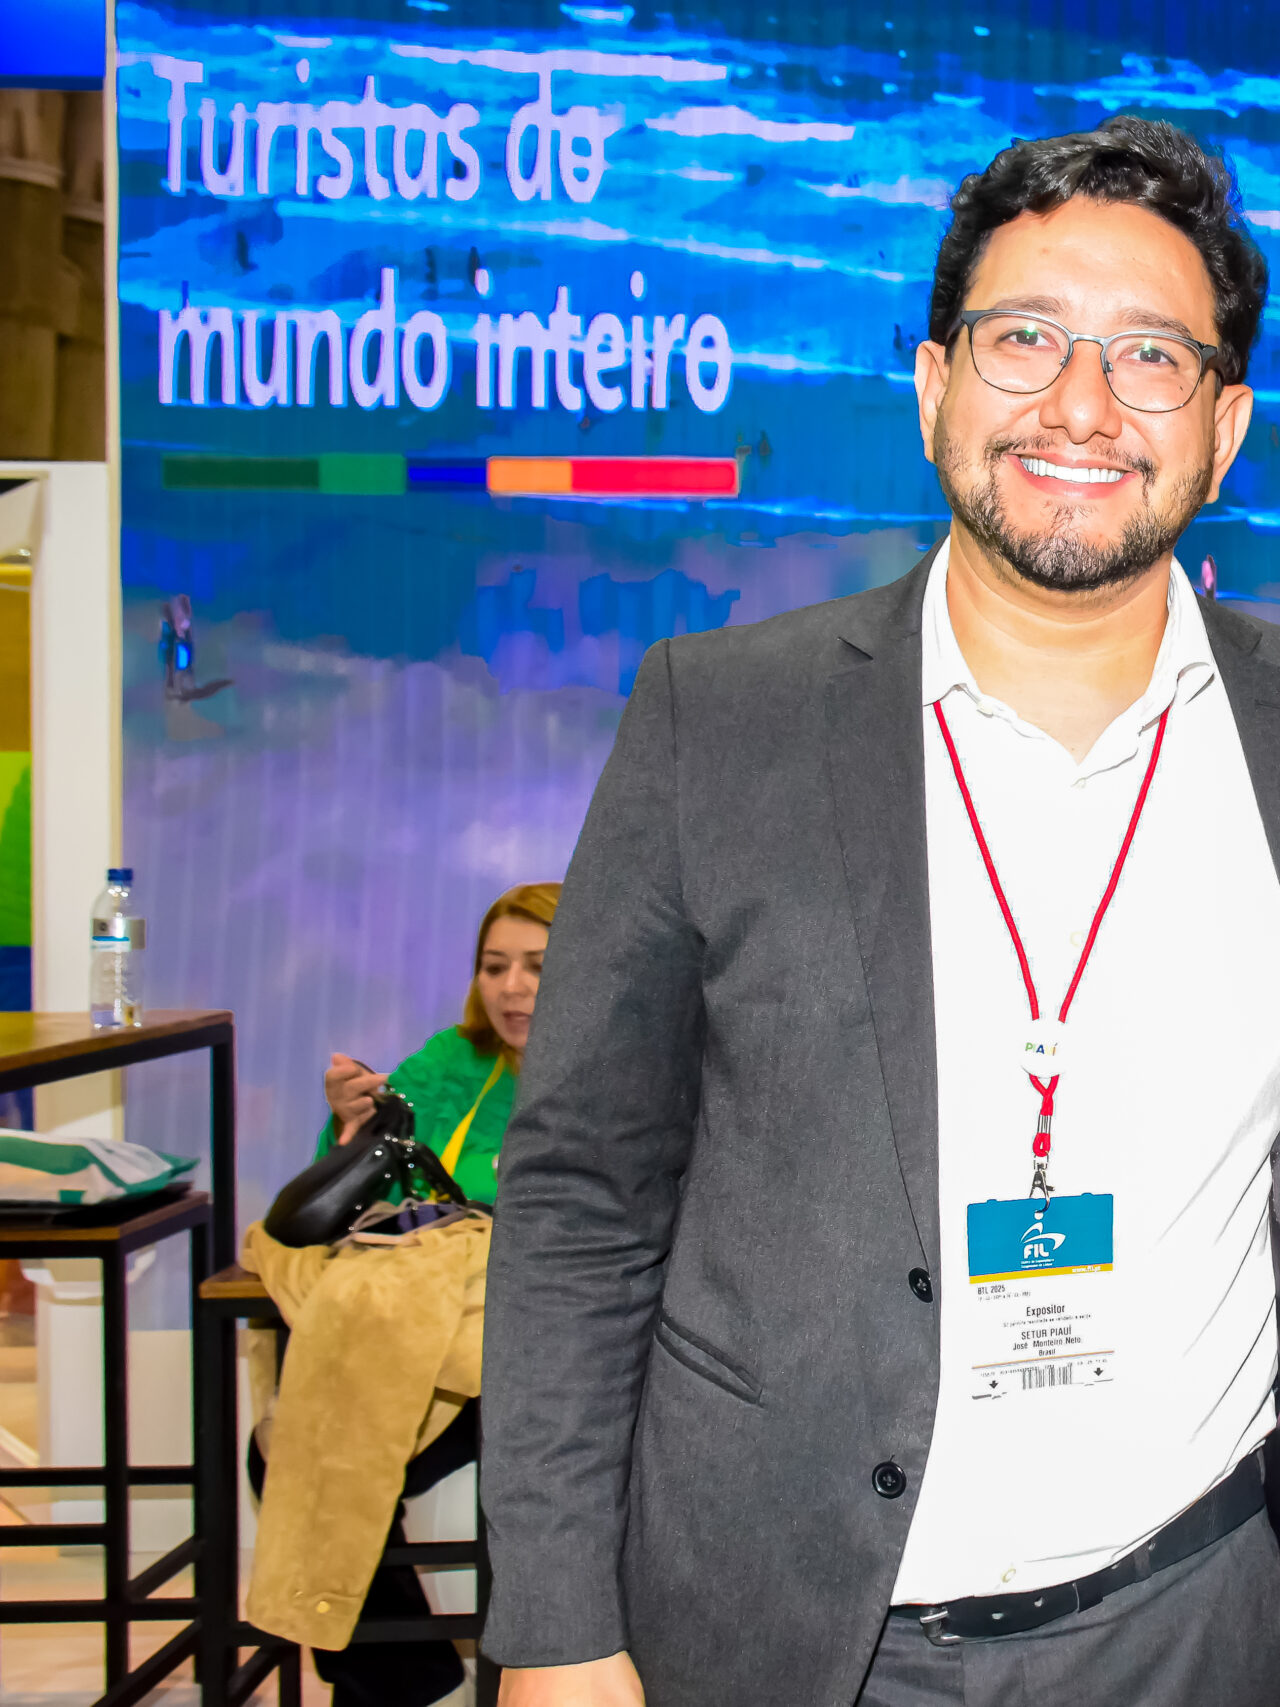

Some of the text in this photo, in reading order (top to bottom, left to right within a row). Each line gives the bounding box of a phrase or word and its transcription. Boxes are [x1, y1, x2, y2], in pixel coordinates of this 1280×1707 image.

[154, 56, 606, 202] Turistas do
[160, 267, 732, 412] mundo inteiro
[1023, 1243, 1050, 1259] FIL
[977, 1284, 1006, 1295] BTL 2025
[1026, 1304, 1065, 1318] Expositor
[1021, 1325, 1072, 1340] SETUR PIAUÍ
[1012, 1336, 1081, 1351] José Monteiro Neto
[1038, 1348, 1056, 1357] Brasil
